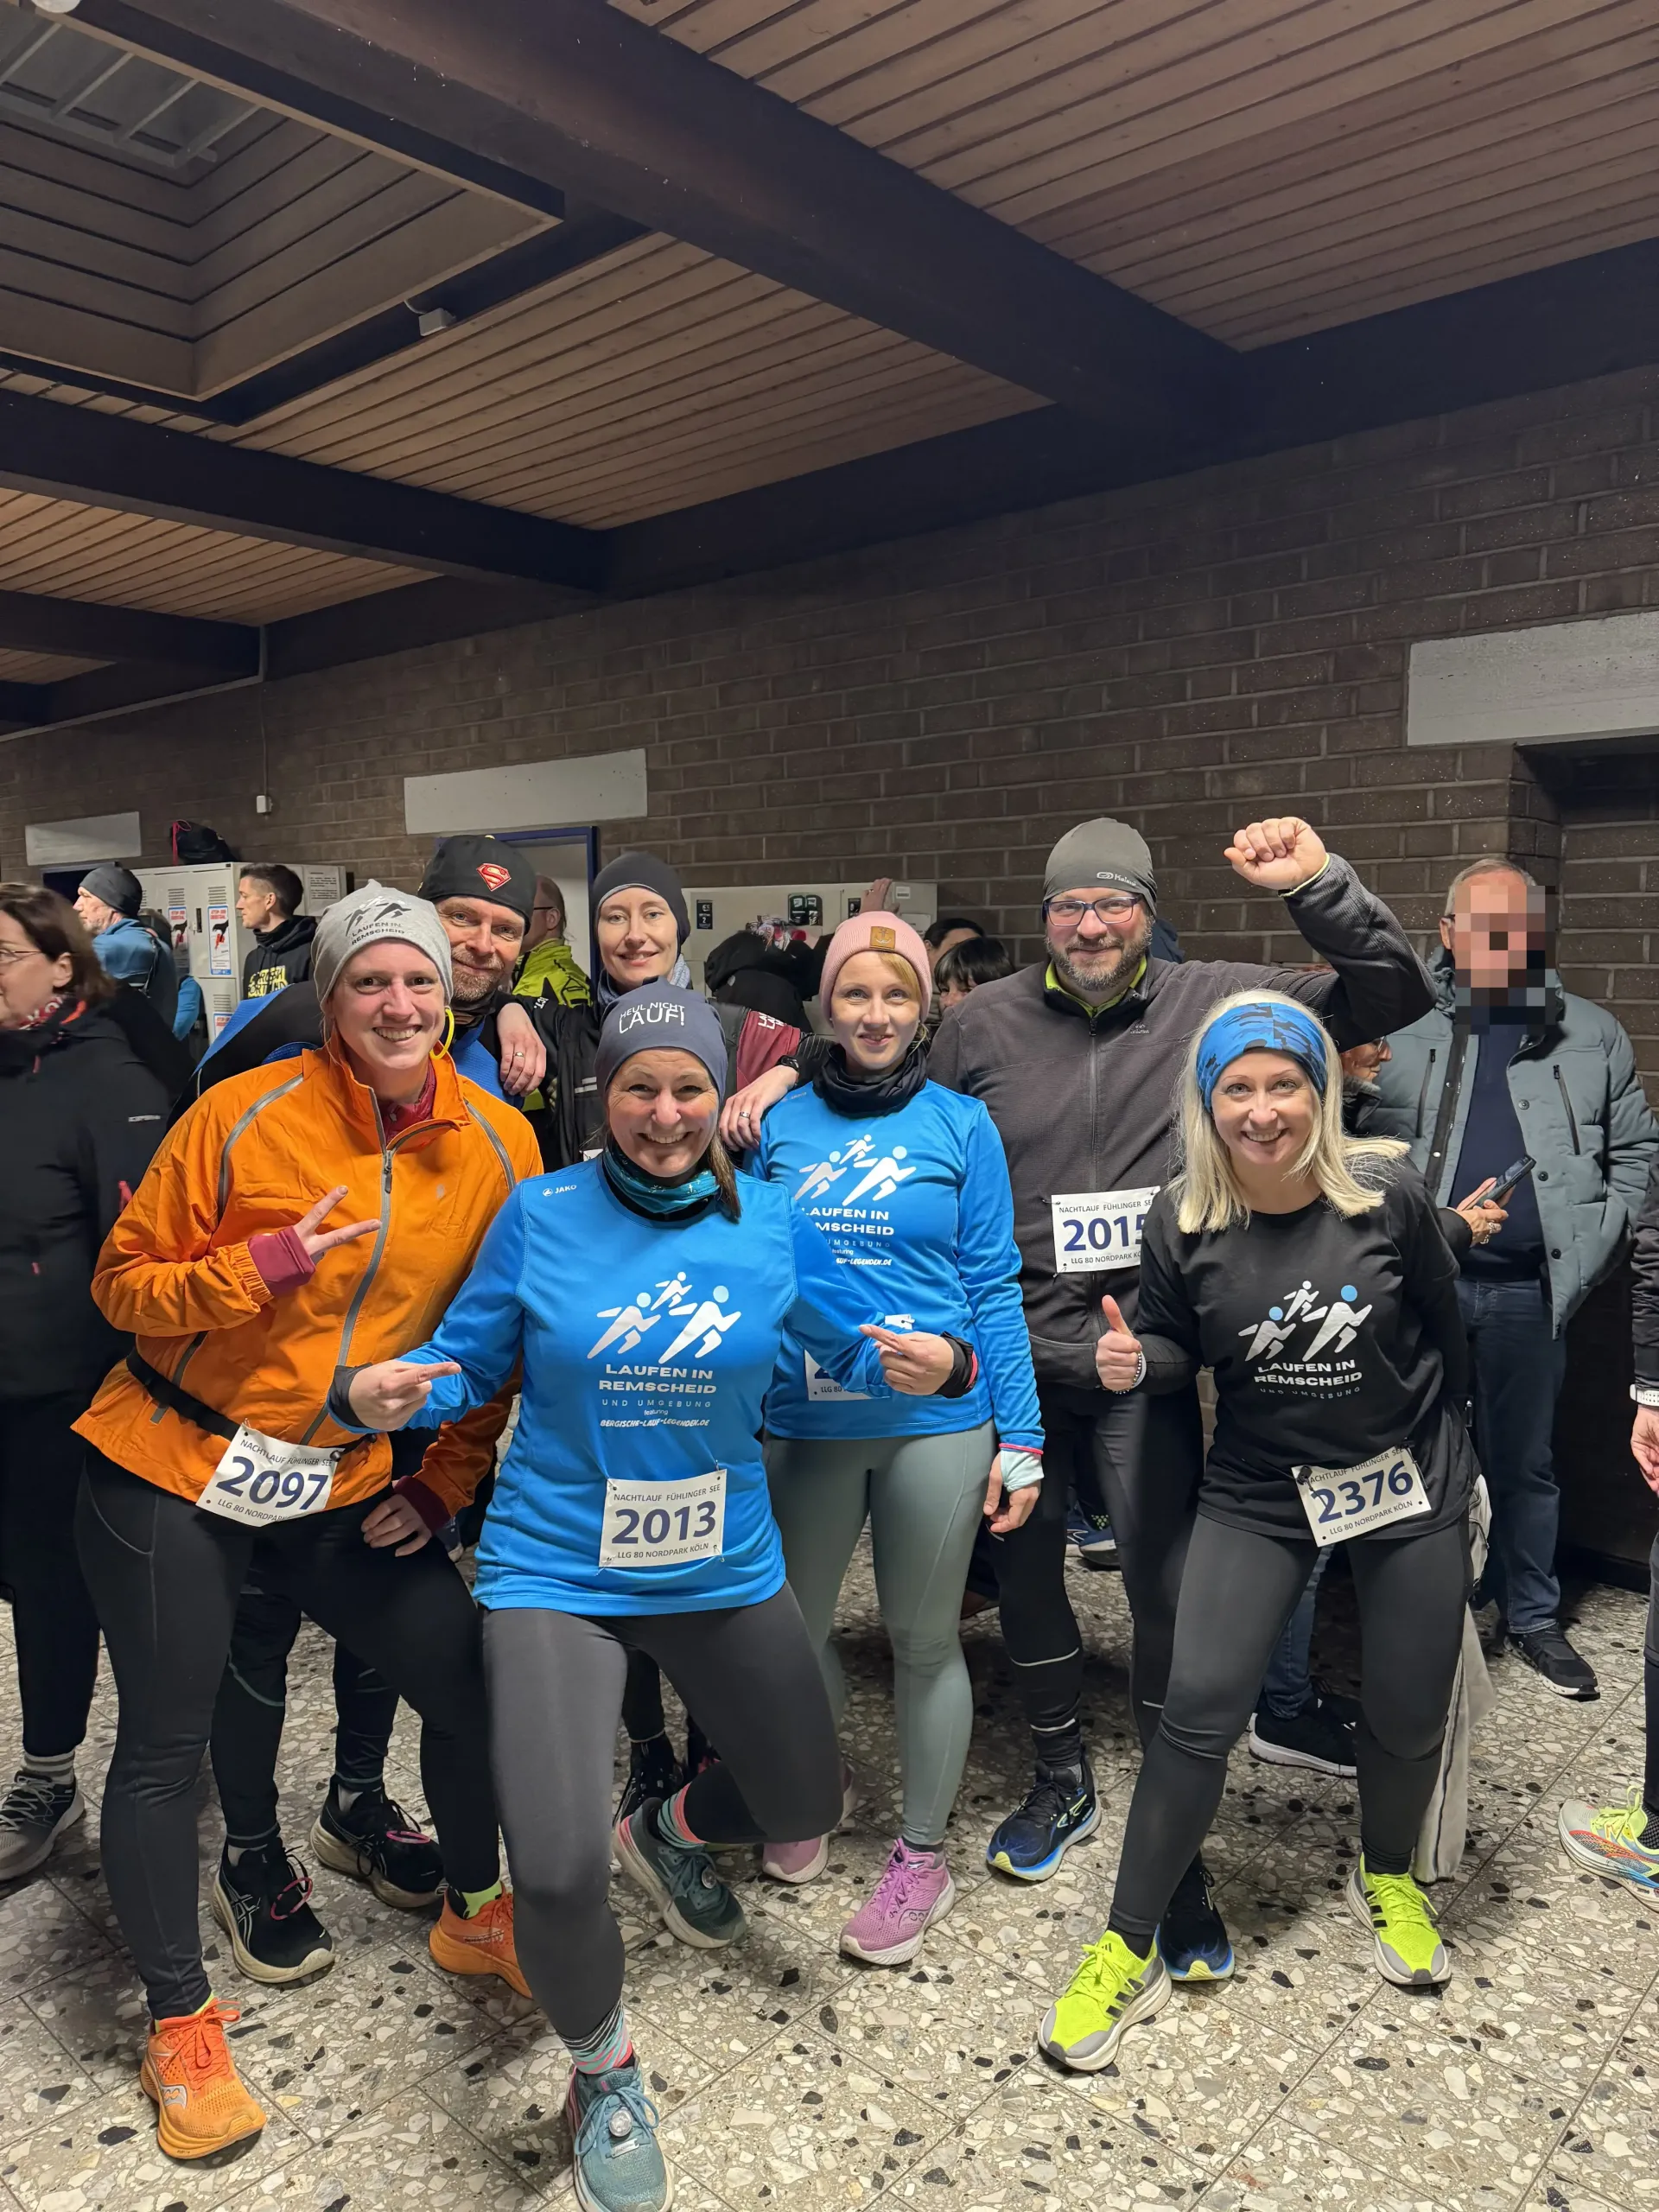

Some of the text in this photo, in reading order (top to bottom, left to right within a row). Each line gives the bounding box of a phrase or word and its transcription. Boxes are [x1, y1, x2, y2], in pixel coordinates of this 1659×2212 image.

[352, 922, 389, 938] LAUFEN
[352, 928, 404, 945] REMSCHEID
[620, 1002, 685, 1019] HEUL NICHT
[619, 1007, 685, 1034] LAUF!
[555, 1185, 577, 1194] JAKO
[1103, 1200, 1141, 1211] FÜHLINGER
[870, 1211, 889, 1220] IN
[815, 1222, 894, 1236] MSCHEID
[1095, 1252, 1132, 1263] NORDPARK
[606, 1363, 714, 1380] LAUFEN IN
[1257, 1359, 1356, 1373] LAUFEN IN
[1254, 1371, 1363, 1386] REMSCHEID
[599, 1380, 717, 1394] REMSCHEID
[638, 1399, 711, 1408] UMGEBUNG
[240, 1440, 286, 1464] NACHTLAUF
[321, 1459, 333, 1467] SEE
[216, 1456, 329, 1510] 2097
[1310, 1469, 1348, 1483] ACHTLAUF
[666, 1488, 707, 1501] FÜHLINGER
[709, 1484, 721, 1493] SEE
[1311, 1460, 1414, 1524] 2376
[218, 1498, 233, 1510] LLG
[233, 1503, 245, 1513] 80
[612, 1500, 716, 1544] 2013
[1329, 1526, 1343, 1535] LLG
[1354, 1508, 1394, 1527] NORDPARK
[1393, 1500, 1414, 1512] KÖLN
[645, 1548, 689, 1558] NORDPARK
[690, 1542, 709, 1553] KÖLN
